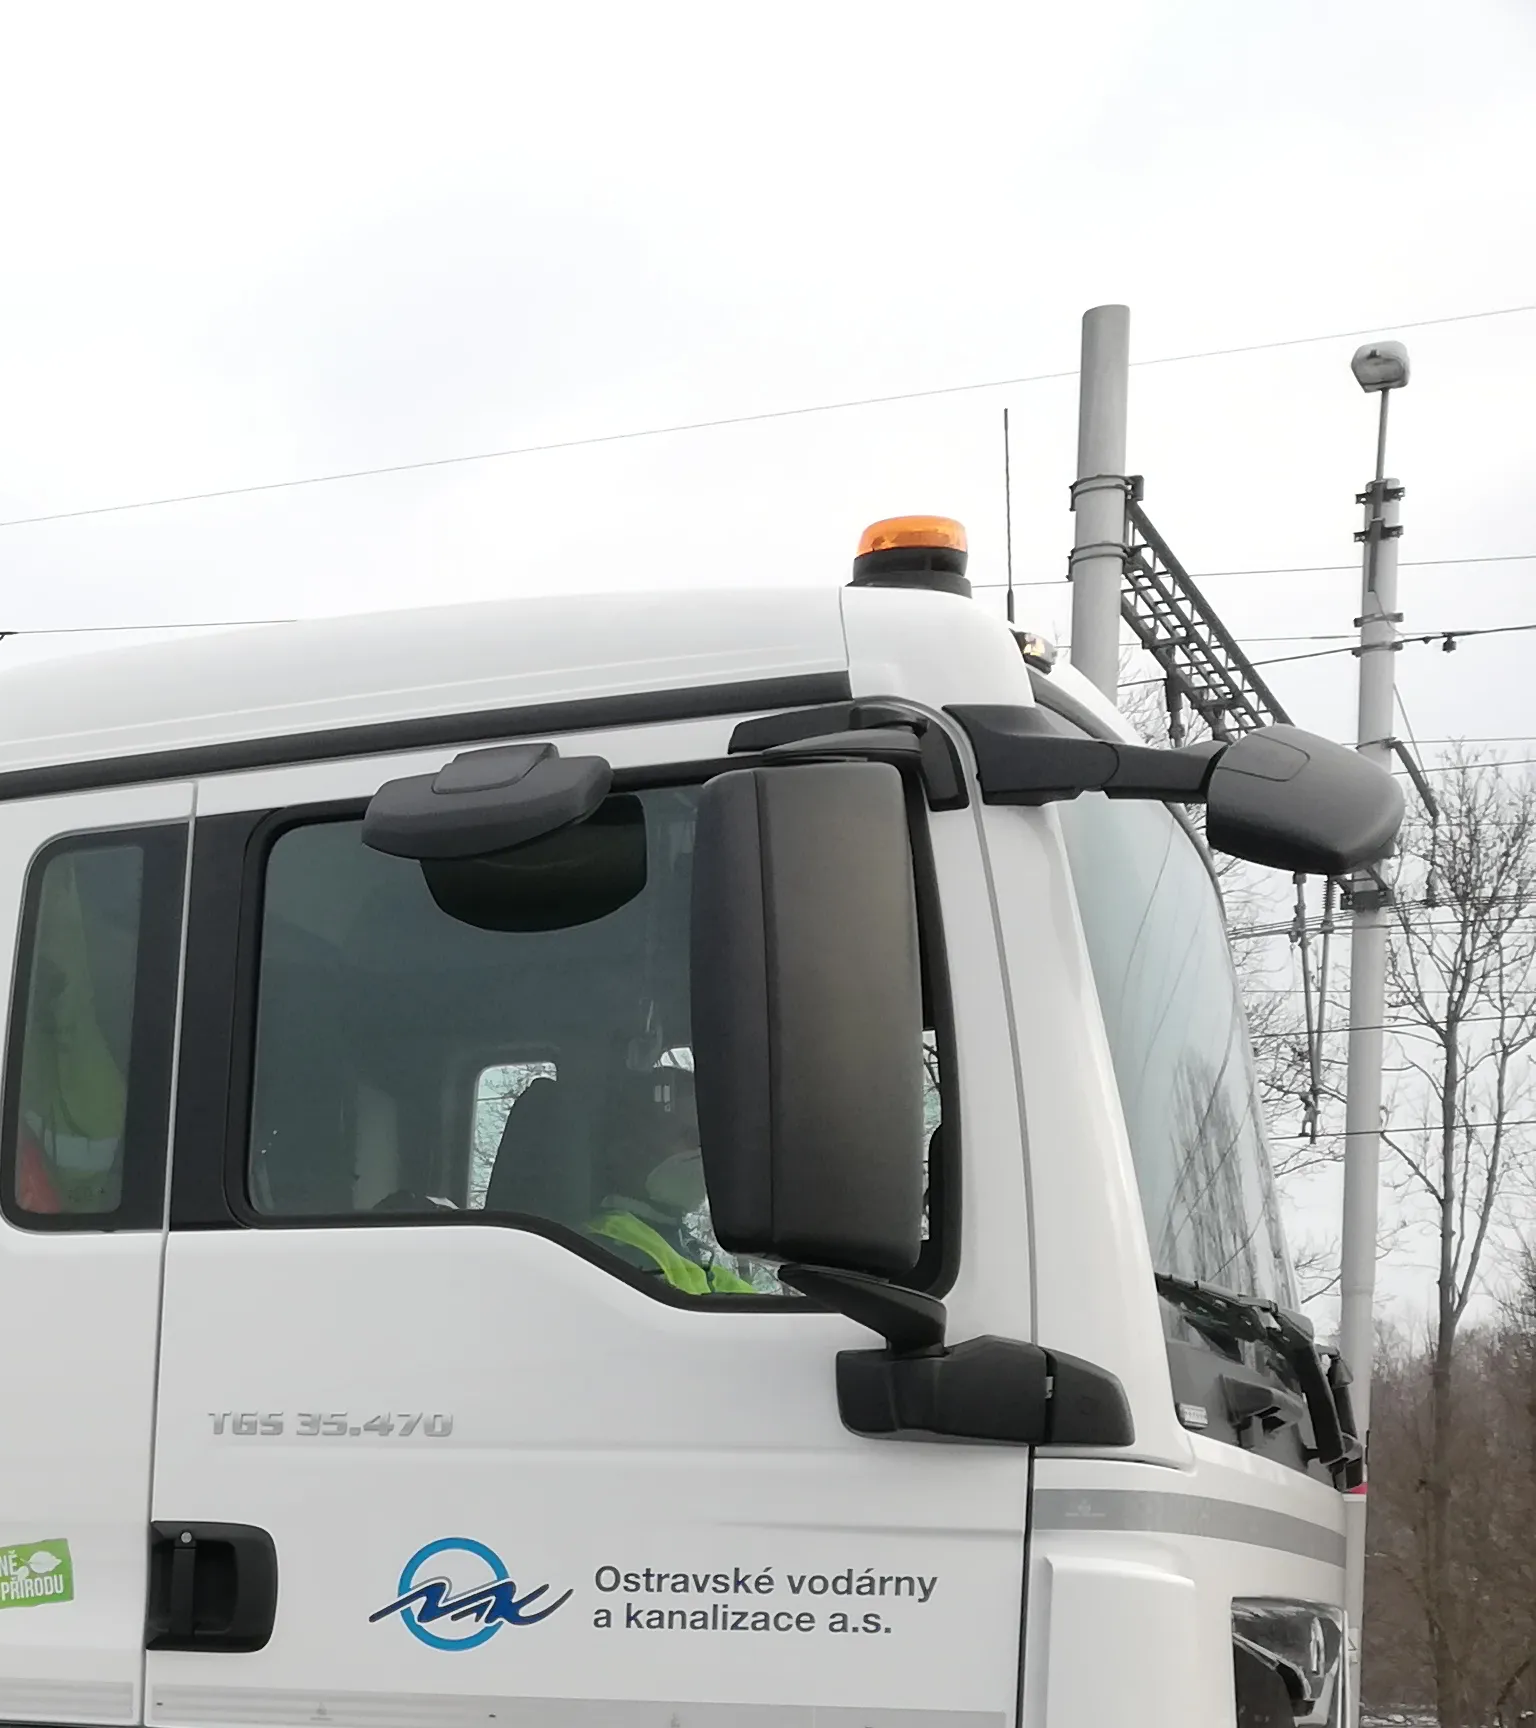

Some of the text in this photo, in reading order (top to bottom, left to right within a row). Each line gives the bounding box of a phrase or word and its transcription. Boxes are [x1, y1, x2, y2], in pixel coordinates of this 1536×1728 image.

[207, 1410, 454, 1438] TGS 35.470
[0, 1574, 65, 1601] PŘÍRODU
[594, 1565, 939, 1603] Ostravské vodárny
[592, 1602, 892, 1634] a kanalizace a.s.
